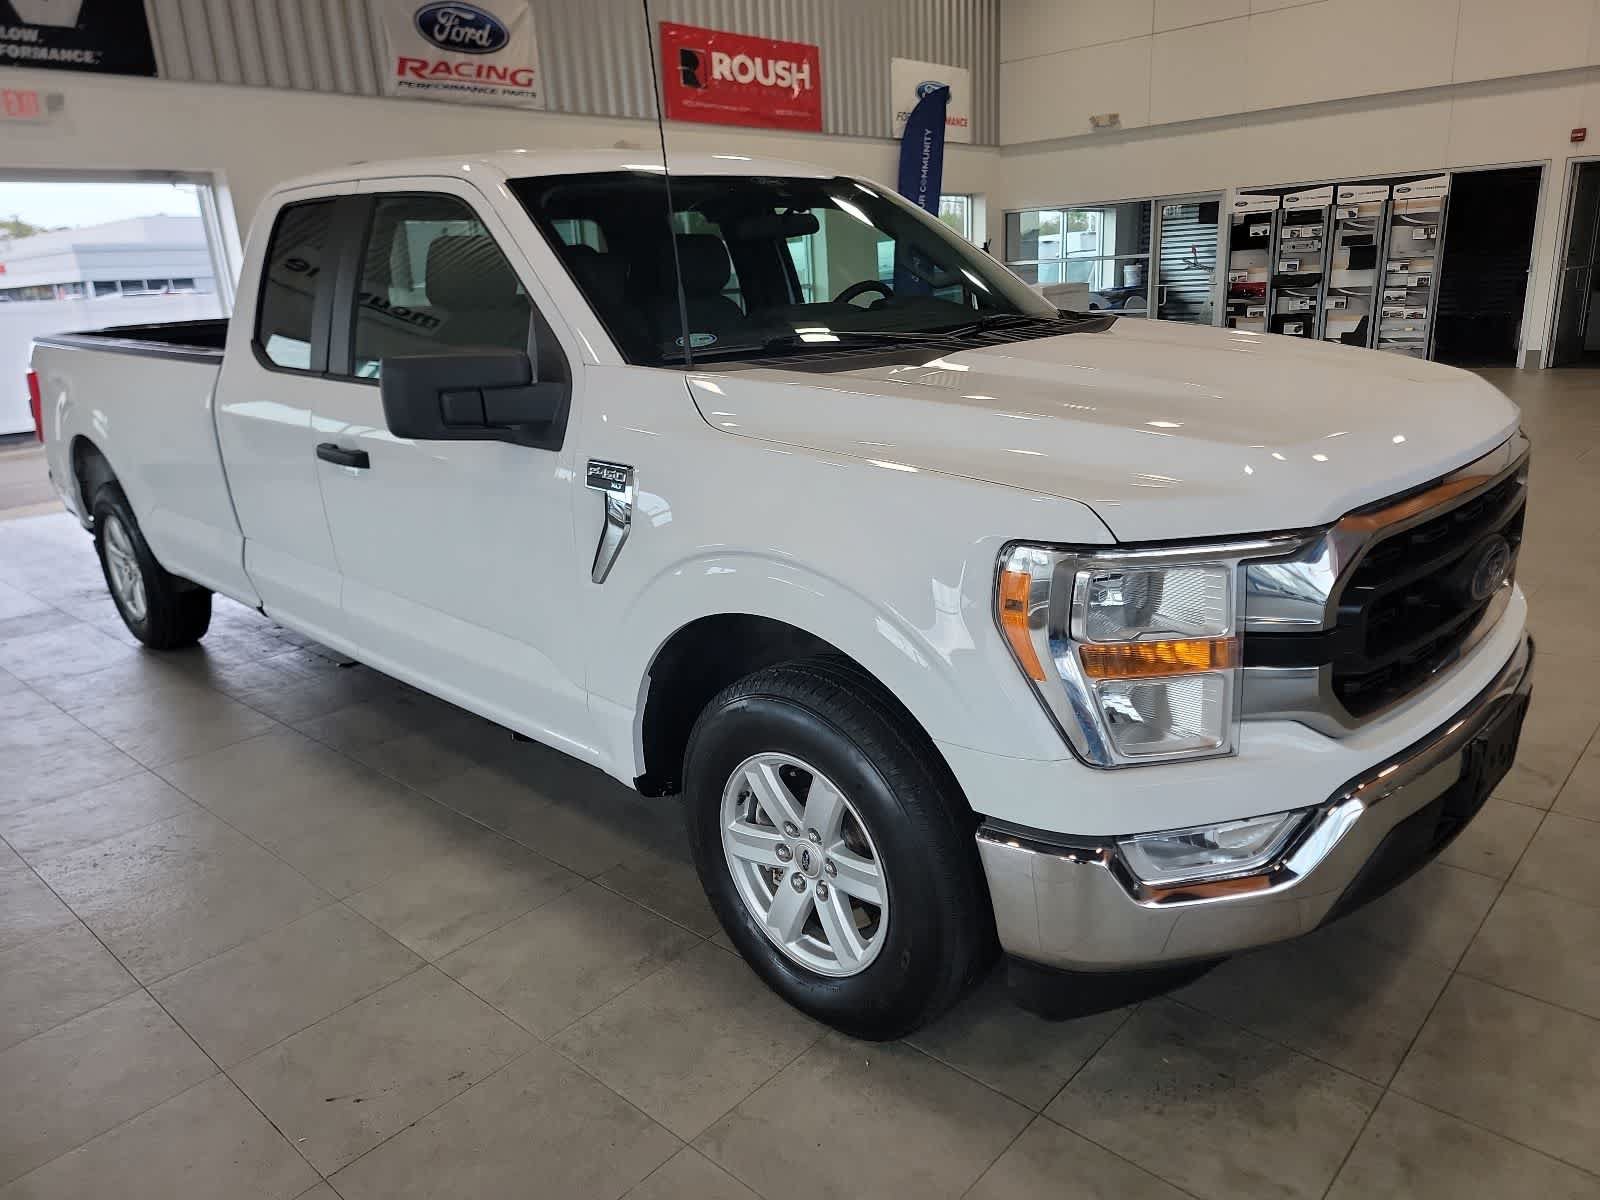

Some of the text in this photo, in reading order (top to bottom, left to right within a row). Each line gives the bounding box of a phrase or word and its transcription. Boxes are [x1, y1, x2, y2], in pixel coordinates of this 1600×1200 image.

[434, 8, 492, 47] Ford
[397, 56, 535, 87] RACING
[711, 51, 811, 90] ROUSH
[920, 128, 933, 193] COMMUNITY
